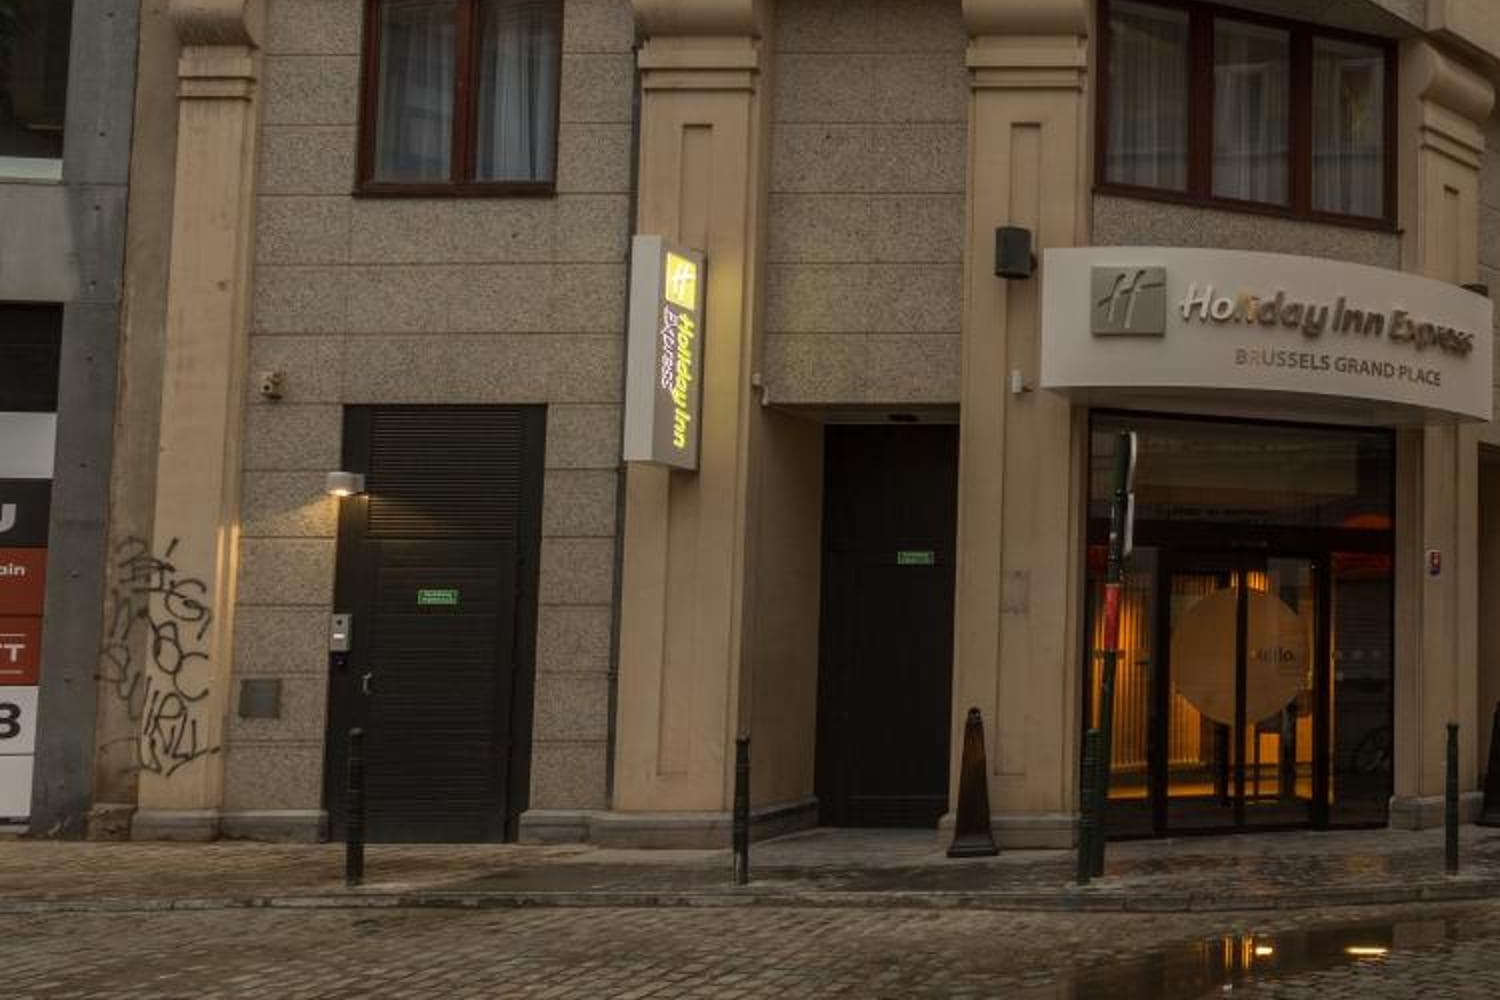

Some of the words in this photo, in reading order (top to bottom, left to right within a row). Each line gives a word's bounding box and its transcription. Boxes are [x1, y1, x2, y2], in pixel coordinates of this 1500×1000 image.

[1332, 296, 1385, 337] Inn
[1235, 347, 1330, 371] BRUSSELS
[1334, 356, 1395, 378] GRAND
[1399, 362, 1441, 388] PLACE
[673, 409, 692, 449] Inn
